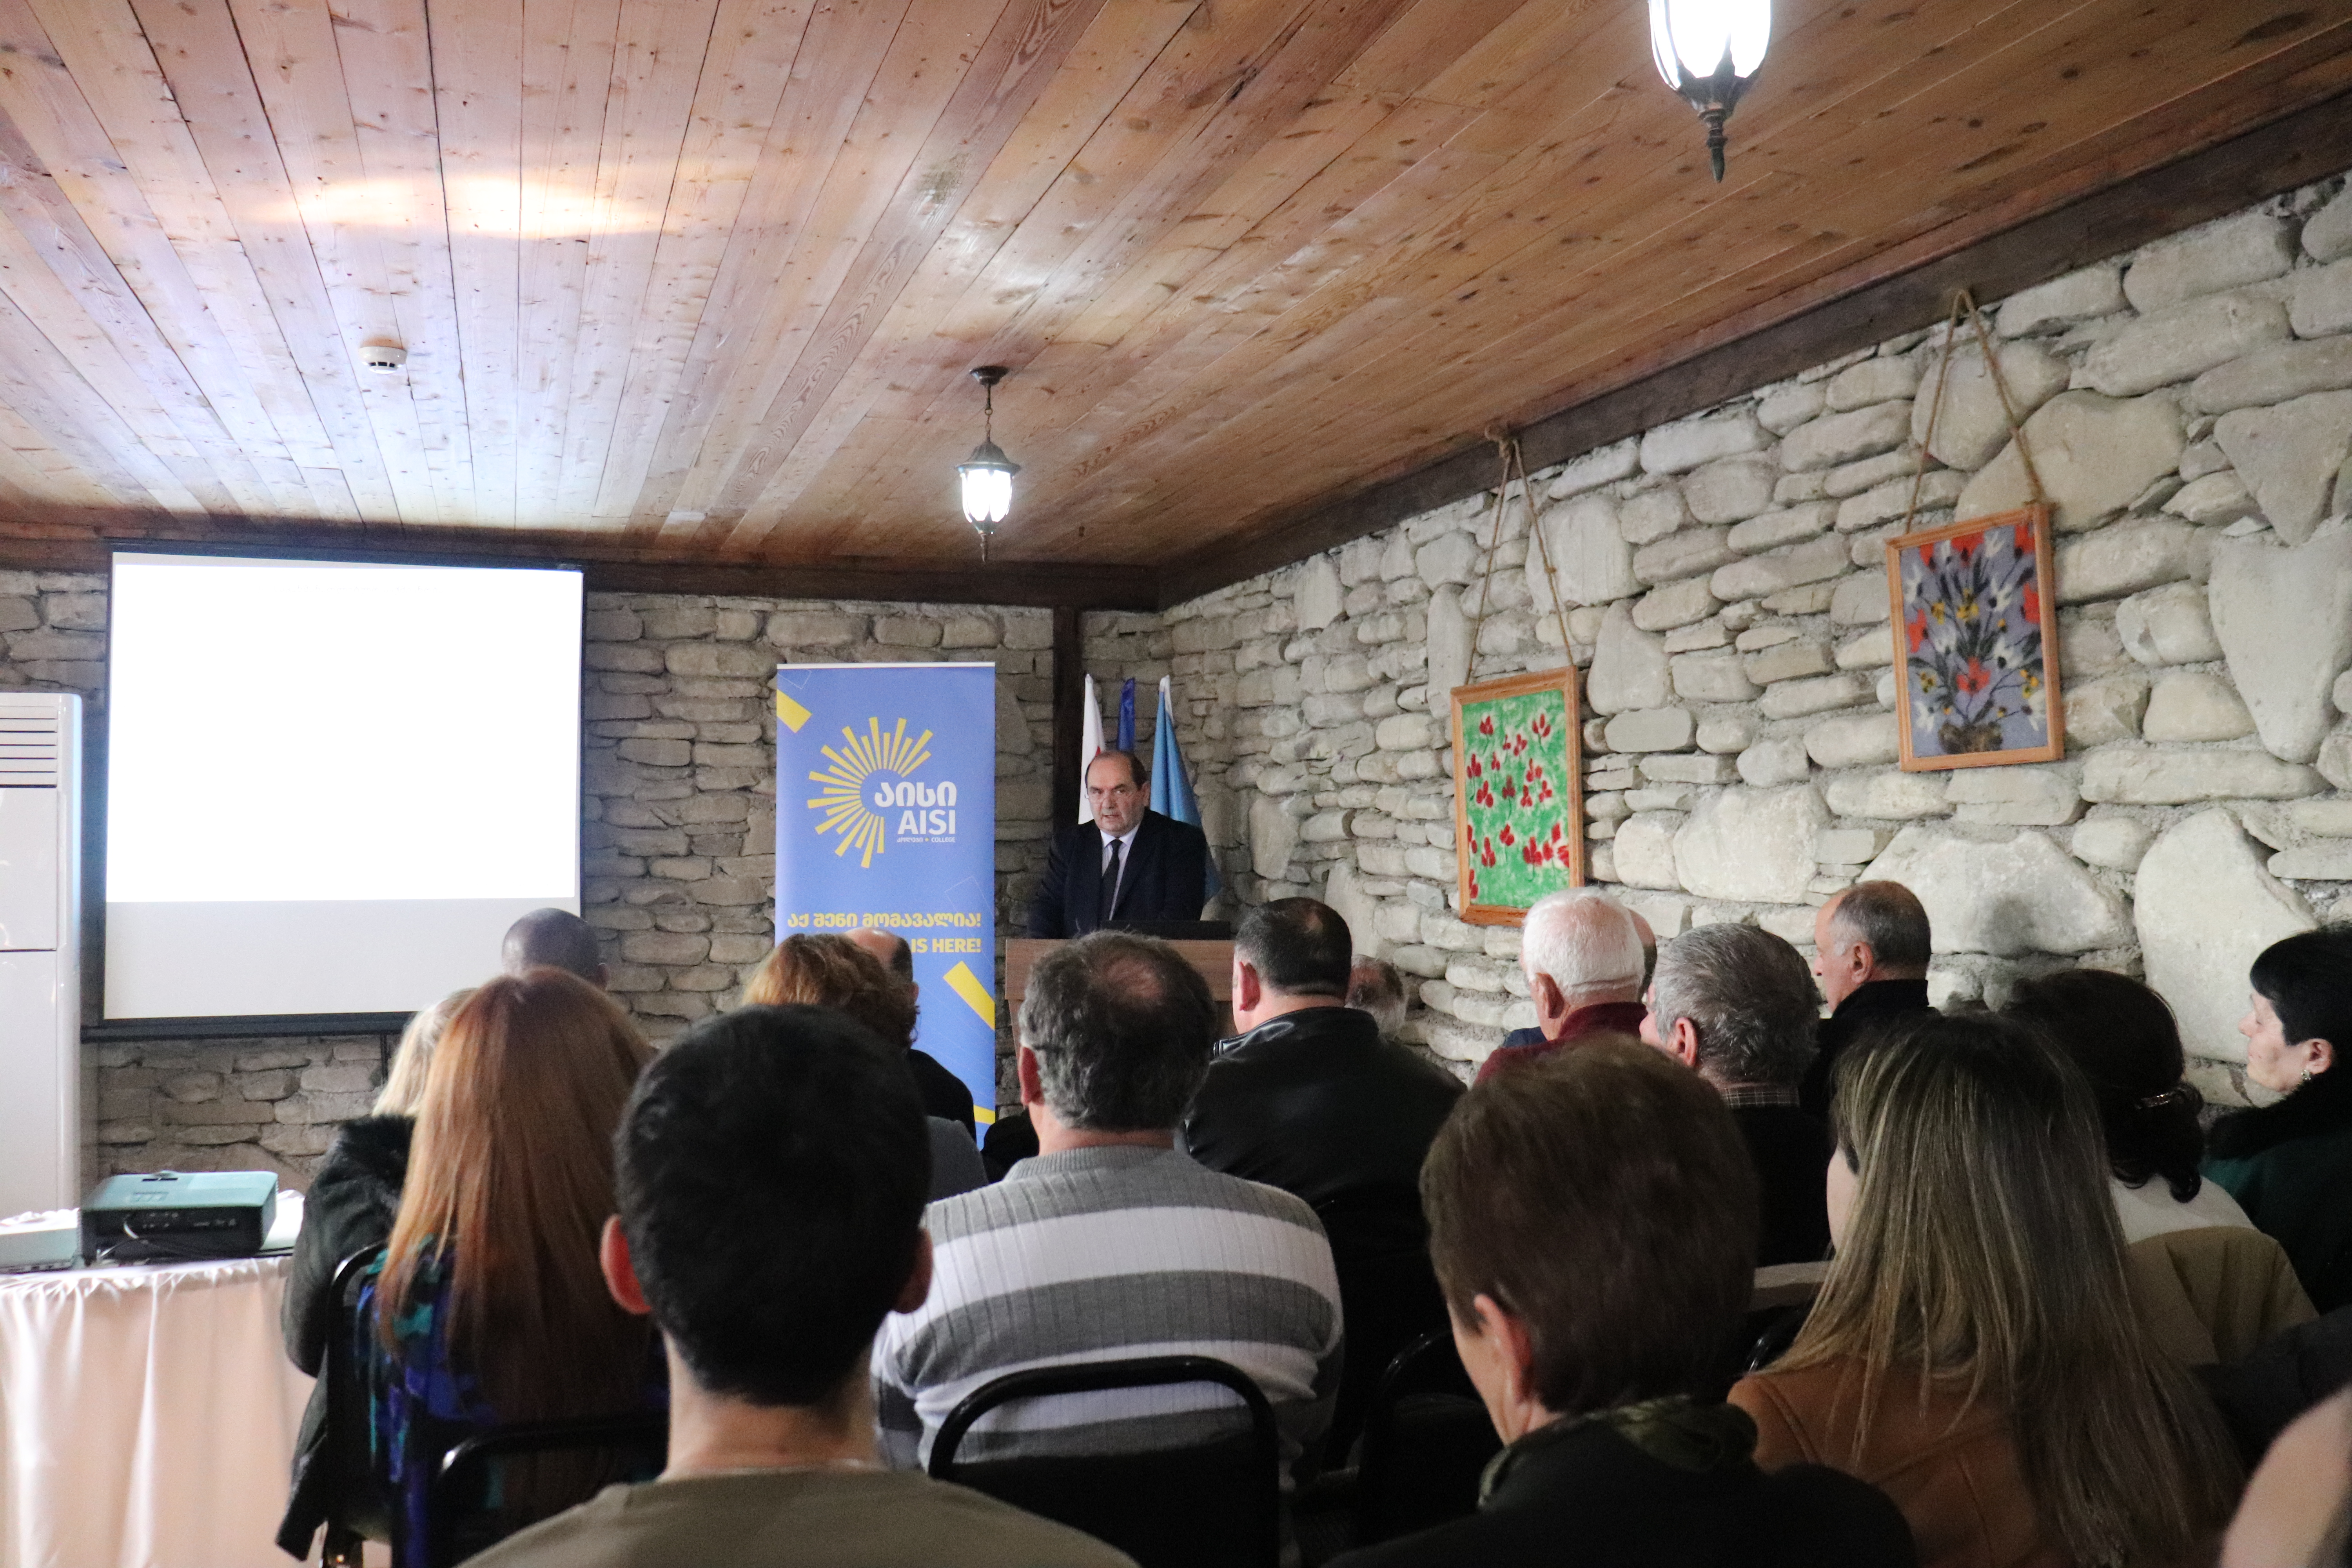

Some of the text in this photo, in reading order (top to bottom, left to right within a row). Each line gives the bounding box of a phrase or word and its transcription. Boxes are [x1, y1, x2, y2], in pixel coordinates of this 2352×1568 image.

[875, 781, 957, 808] აისი
[898, 809, 956, 835] AISI
[788, 913, 809, 927] აქ
[813, 913, 858, 927] შენი
[911, 938, 981, 953] IS HERE!
